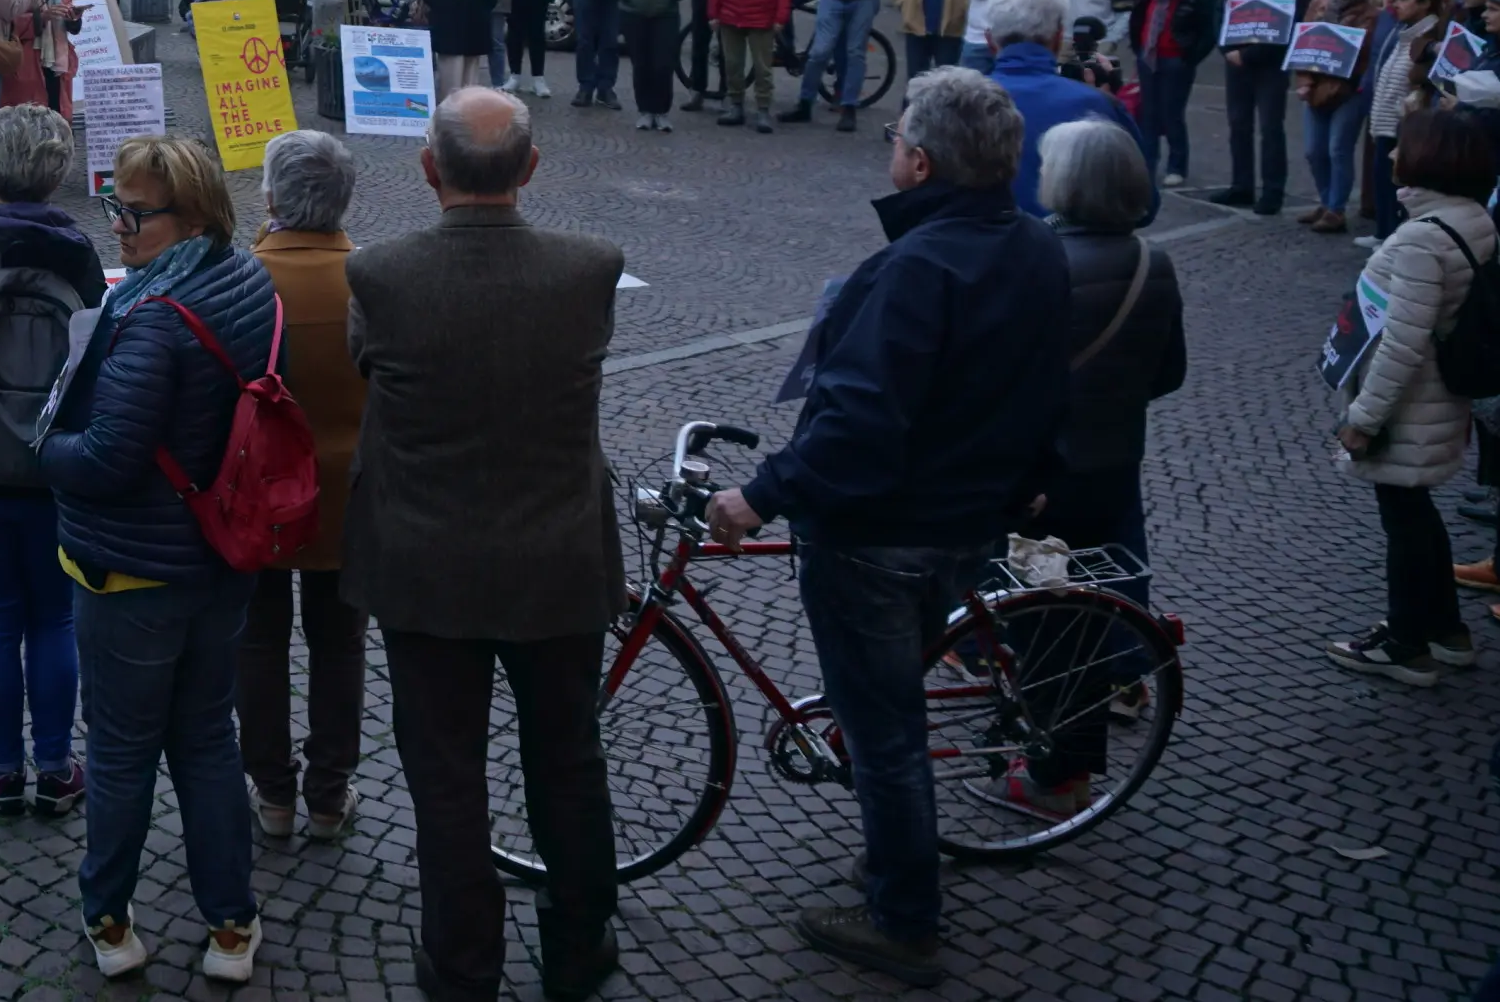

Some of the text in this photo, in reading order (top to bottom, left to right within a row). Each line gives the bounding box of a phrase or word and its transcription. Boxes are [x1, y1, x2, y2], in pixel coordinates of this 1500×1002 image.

[215, 76, 281, 96] IMAGINE
[219, 96, 248, 109] ALL
[220, 109, 250, 124] THE
[224, 119, 283, 138] PEOPLE
